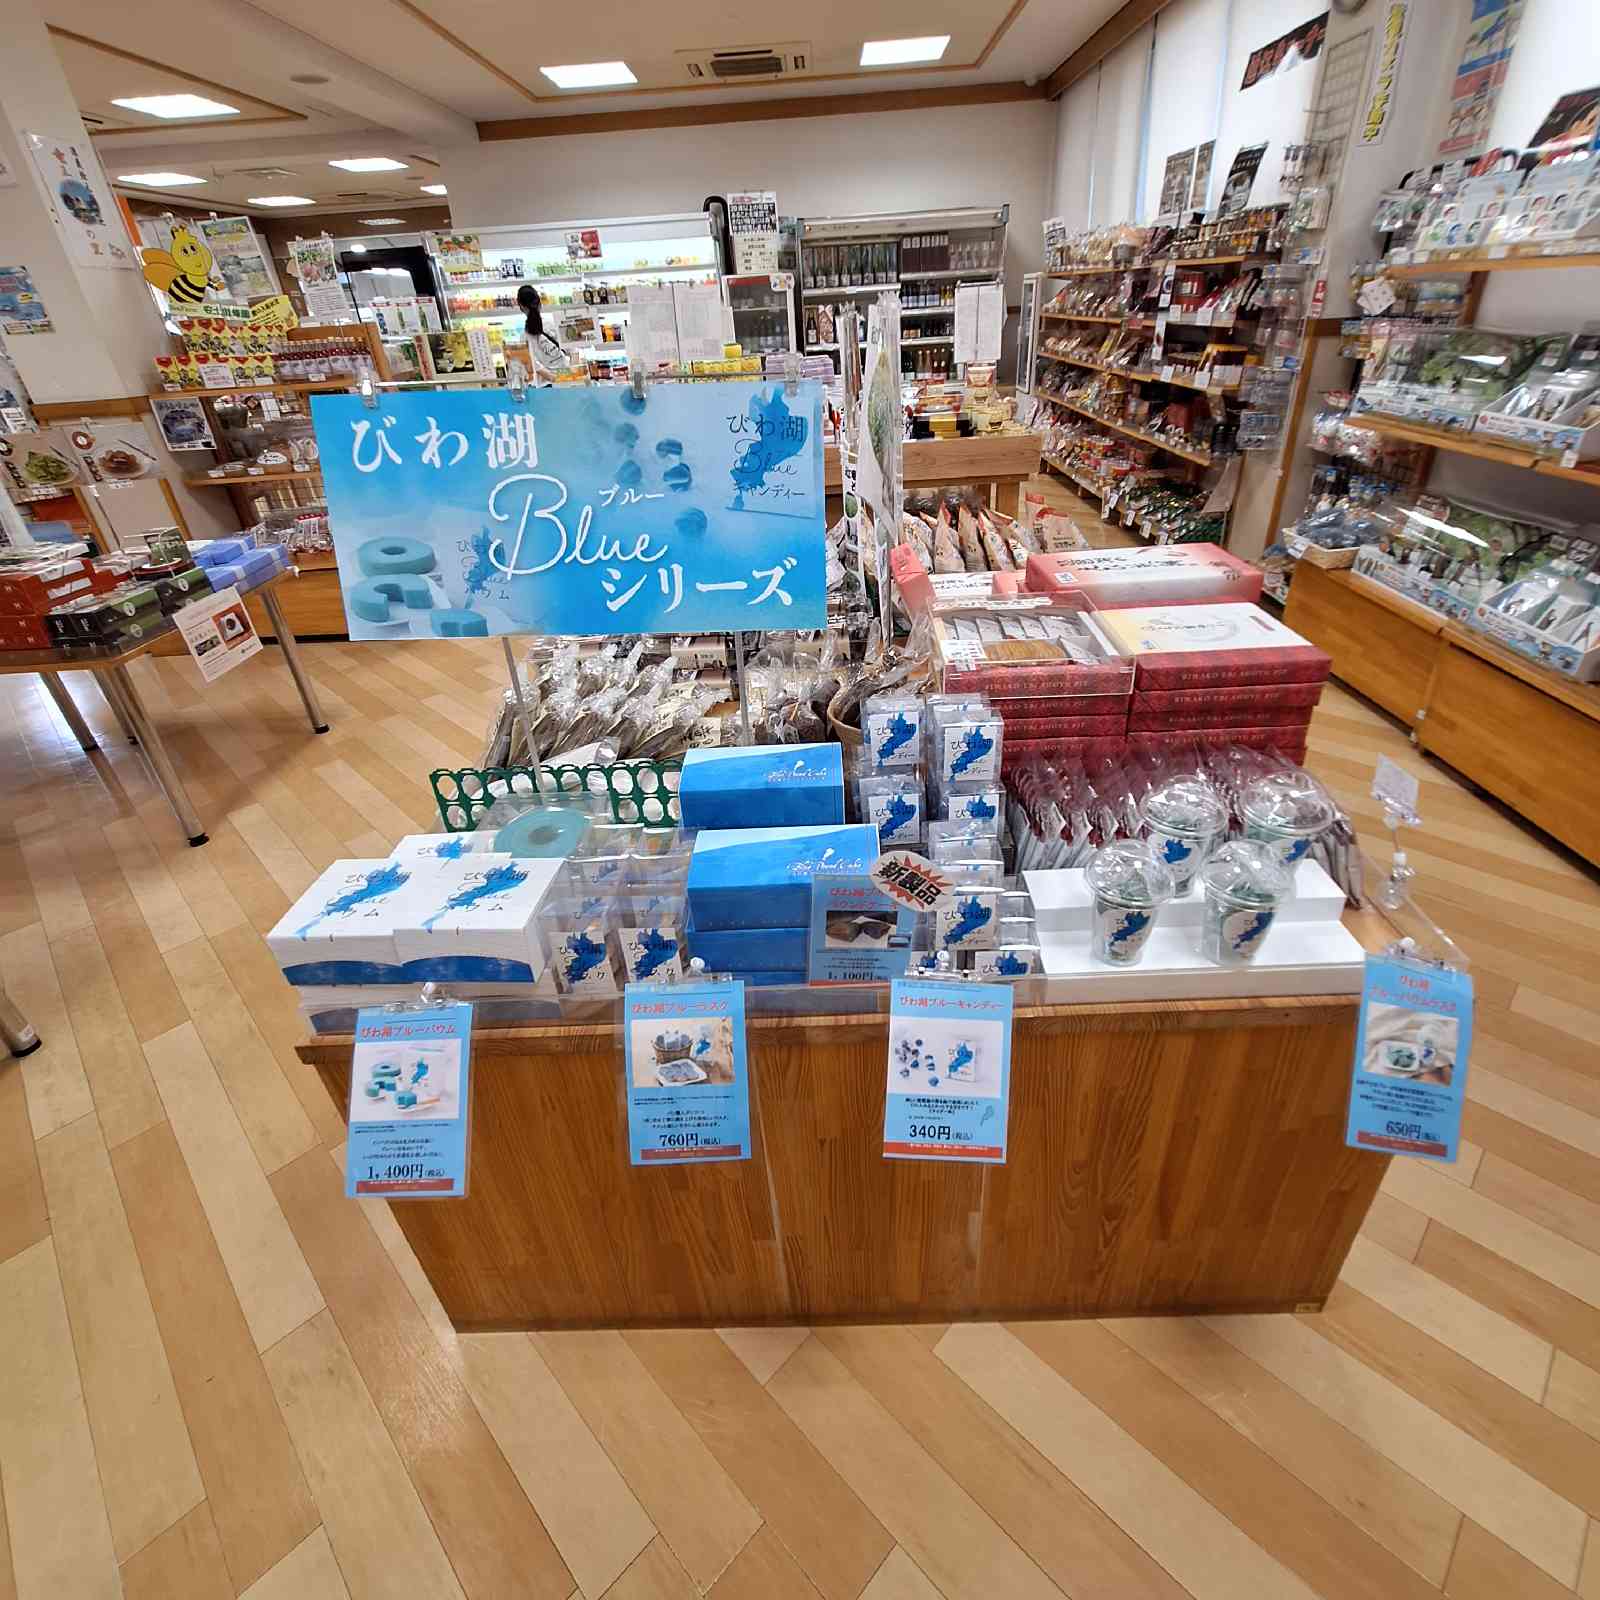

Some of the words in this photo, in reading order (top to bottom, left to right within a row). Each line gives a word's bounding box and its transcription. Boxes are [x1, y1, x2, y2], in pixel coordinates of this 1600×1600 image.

[351, 412, 539, 473] びわ湖
[598, 484, 666, 506] ブルー
[488, 473, 669, 581] Blue
[602, 557, 799, 615] シリーズ
